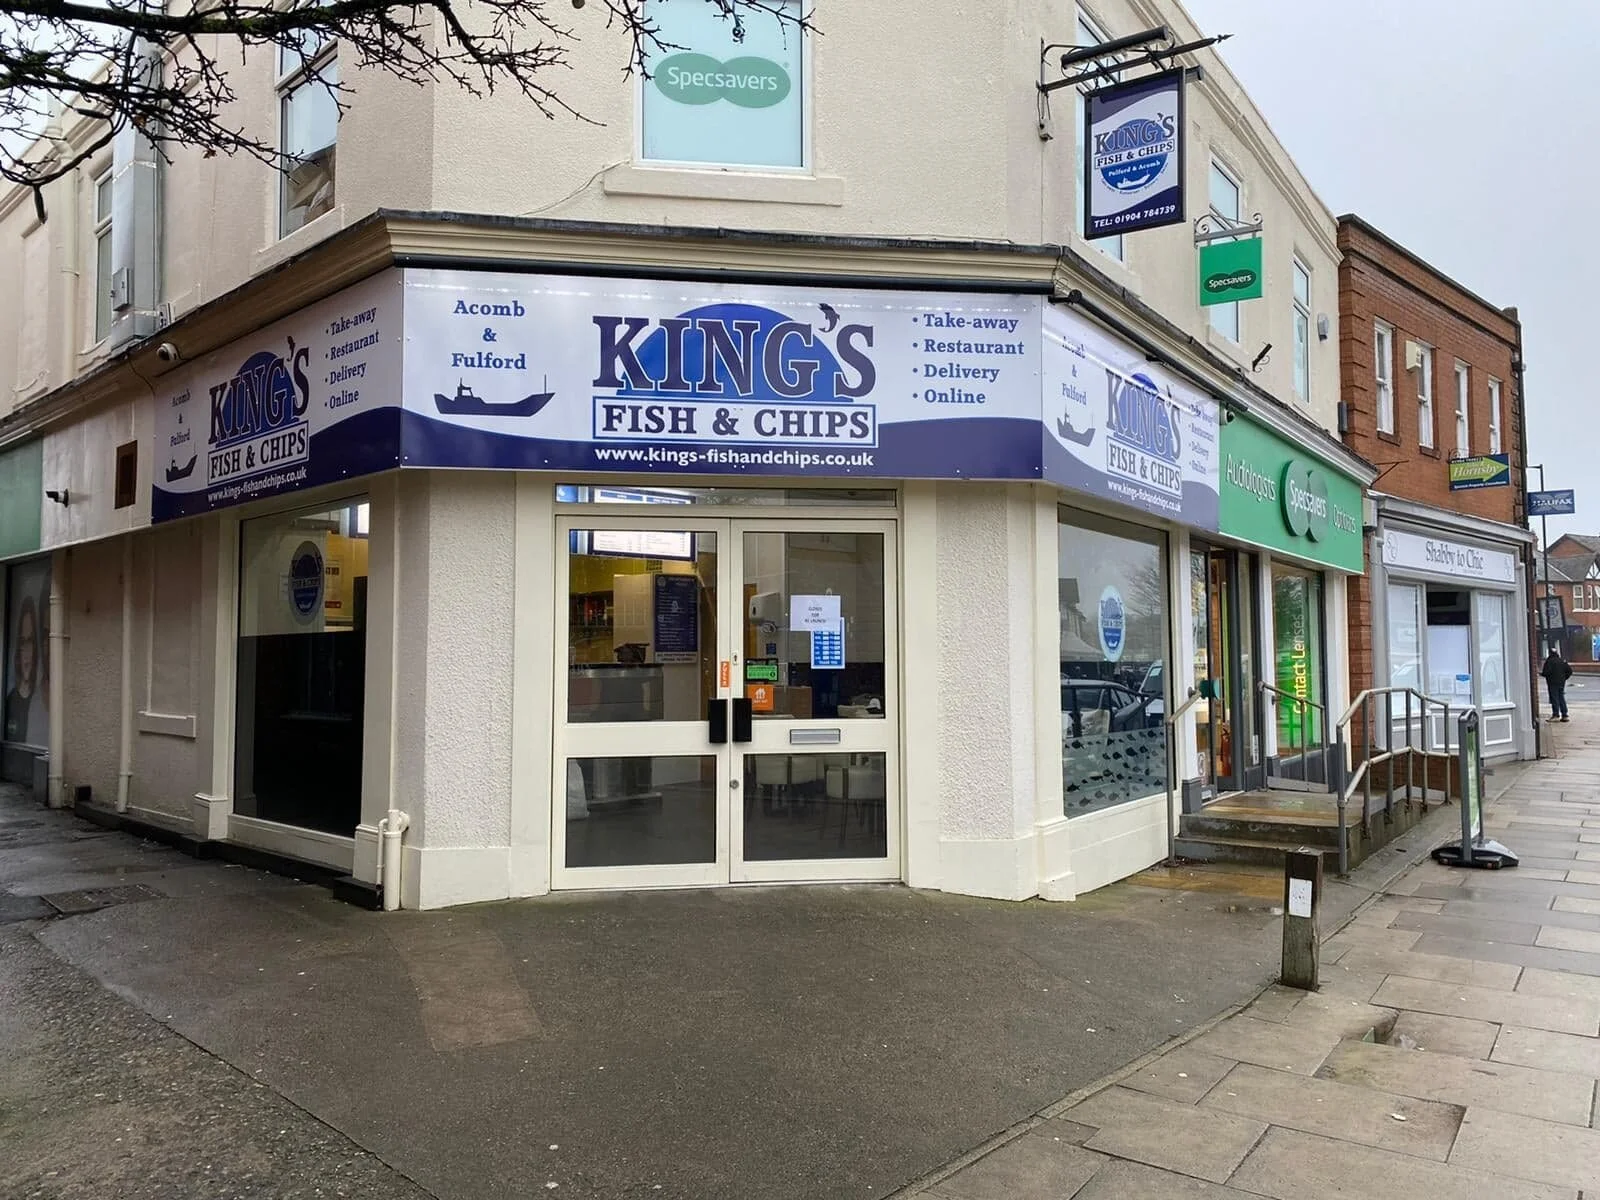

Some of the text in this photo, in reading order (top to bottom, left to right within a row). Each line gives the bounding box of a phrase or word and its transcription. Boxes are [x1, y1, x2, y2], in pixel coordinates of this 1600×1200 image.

[667, 66, 778, 91] Specsavers
[1094, 112, 1175, 155] KING'S
[1097, 141, 1173, 167] FISH & CHIPS
[1094, 204, 1176, 228] TEL: 01904 784739
[1208, 273, 1252, 289] Specsavers
[453, 299, 526, 318] Acomb
[330, 307, 377, 337] Take-away
[482, 327, 498, 342] &
[923, 313, 1019, 333] Take-away
[330, 331, 379, 360] Restaurant
[592, 303, 876, 398] KING'S
[924, 339, 1025, 355] Restaurant
[330, 360, 366, 385] Delivery
[451, 352, 527, 370] Fulford
[924, 363, 1001, 383] Delivery
[208, 336, 310, 445] KING'S
[329, 387, 360, 410] Online
[924, 388, 986, 404] Online
[1062, 383, 1087, 406] Fulford
[602, 405, 870, 439] FISH & CHIPS
[1105, 368, 1182, 461] KING'S
[210, 428, 306, 479] FISH & CHIPS
[594, 448, 875, 467] www.kings-fishandchips.co.uk
[1109, 442, 1181, 491] FISH & CHIPS
[1226, 453, 1276, 504] Audiologists
[1453, 461, 1499, 477] Hornsby
[208, 466, 307, 503] www.kings-fishandchips.co.uk
[1289, 480, 1327, 518] Specsavers
[1426, 540, 1455, 565] Shabby
[1457, 549, 1465, 567] to
[1467, 549, 1484, 570] Chic
[1292, 614, 1305, 660] Lenses
